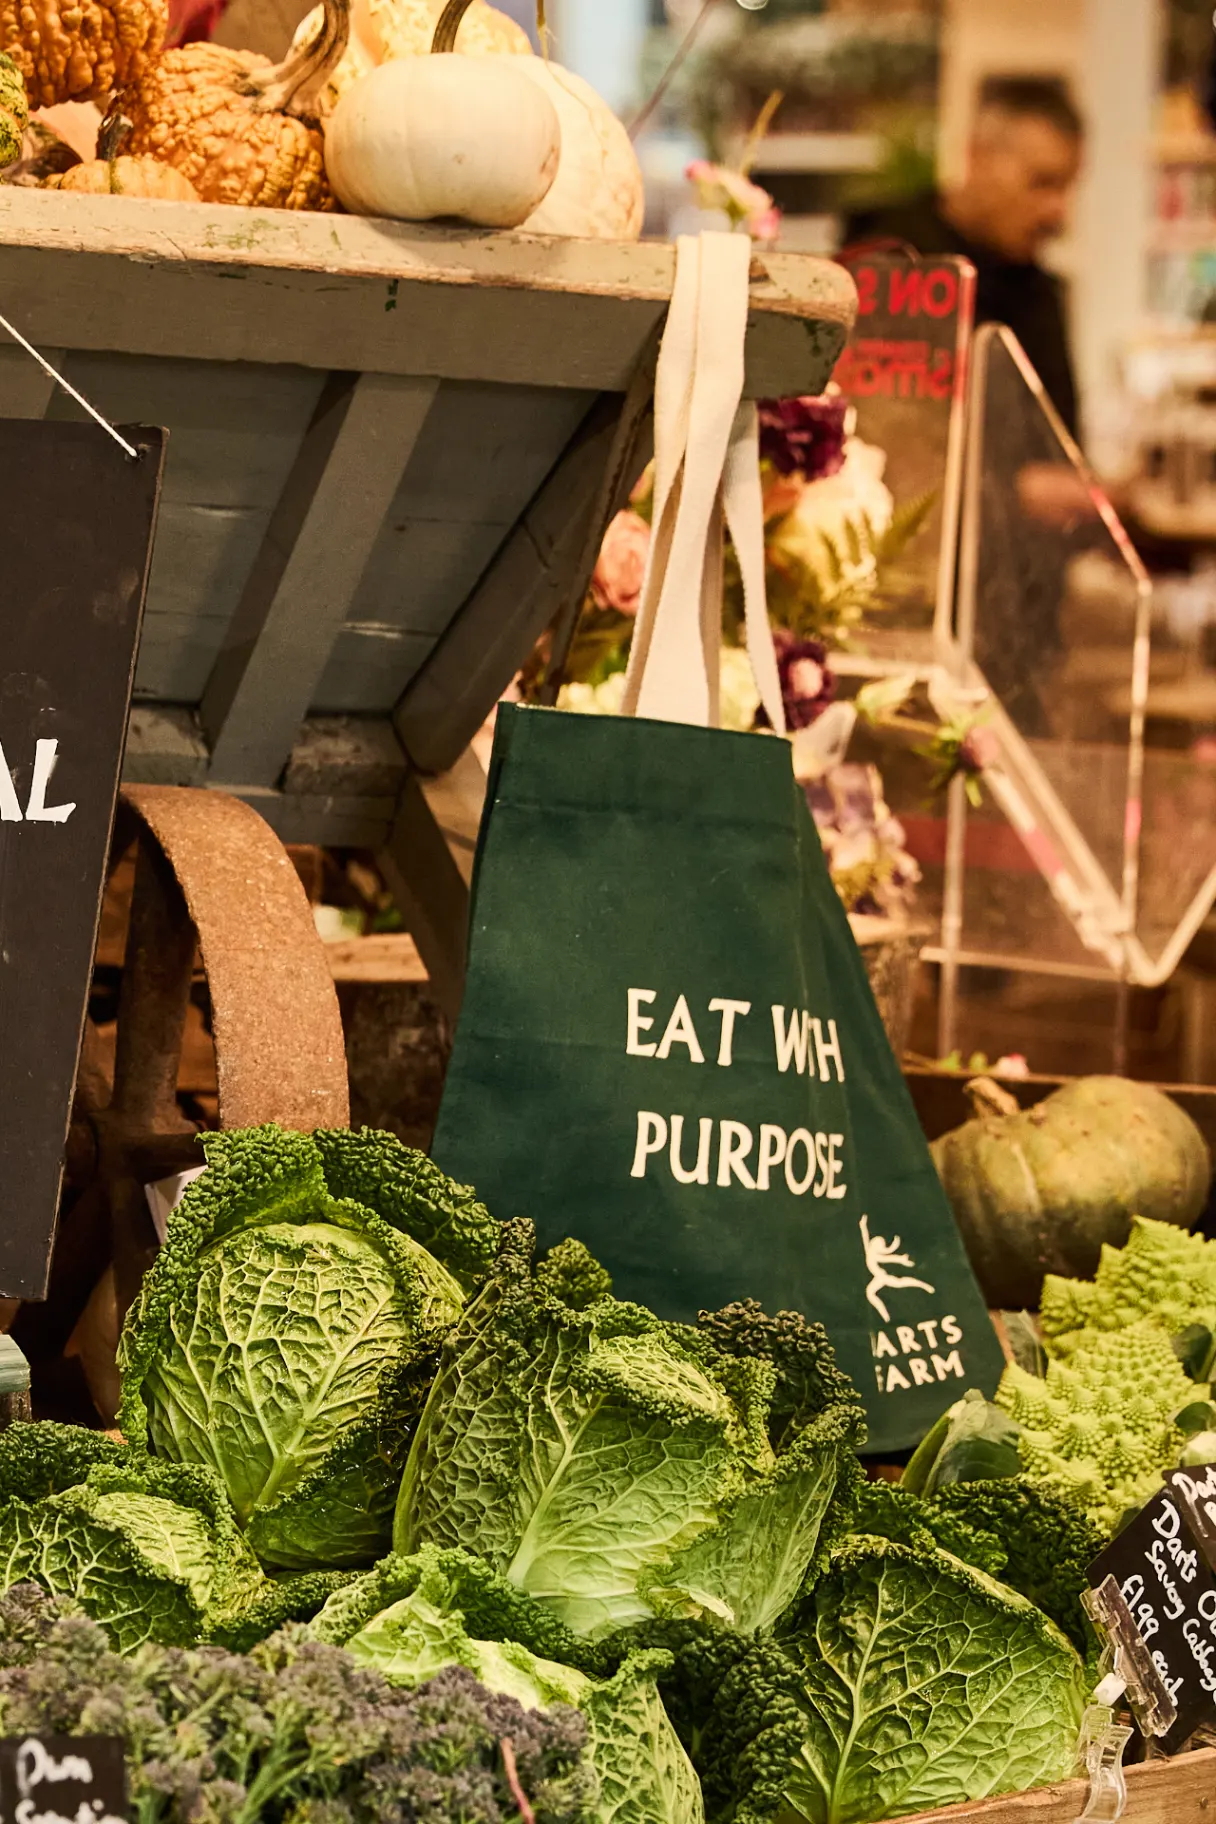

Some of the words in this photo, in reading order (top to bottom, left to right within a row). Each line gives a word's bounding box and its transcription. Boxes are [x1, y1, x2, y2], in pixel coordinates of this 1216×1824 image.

[626, 988, 751, 1066] EAT
[631, 1111, 846, 1199] PURPOSE
[869, 1314, 963, 1359] ARTS
[1151, 1498, 1198, 1583] Darts
[1144, 1540, 1186, 1620] Savoy
[1183, 1618, 1216, 1705] Cabbag
